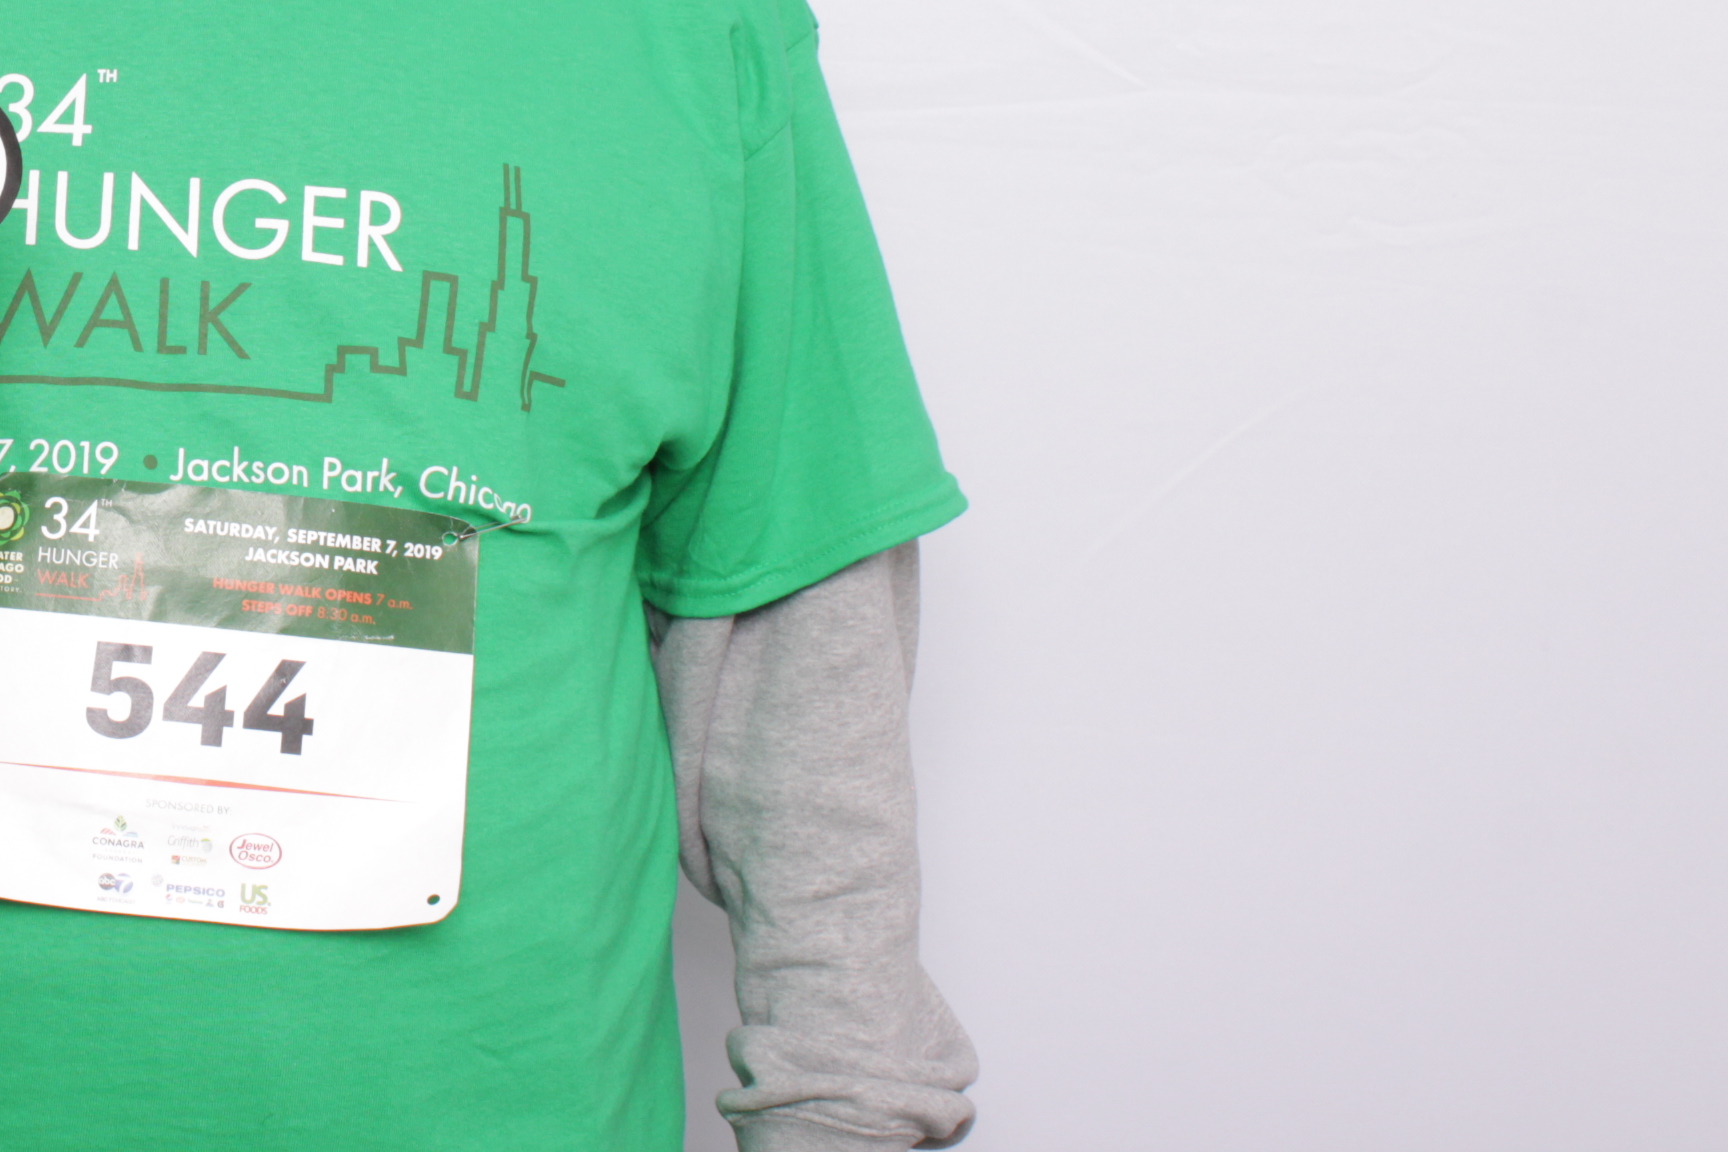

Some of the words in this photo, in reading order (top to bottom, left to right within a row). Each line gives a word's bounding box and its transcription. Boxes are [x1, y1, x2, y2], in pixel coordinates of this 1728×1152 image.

[29, 438, 120, 475] 2019
[169, 446, 309, 487] Jackson
[322, 456, 403, 498] Park,
[184, 518, 280, 543] SATURDAY,
[287, 528, 381, 554] SEPTEMBER
[385, 539, 398, 557] 7,
[403, 542, 443, 561] 2019
[37, 546, 119, 569] HUNGER
[245, 547, 329, 569] JACKSON
[333, 555, 379, 575] PARK
[37, 569, 91, 588] WALK
[213, 577, 274, 594] HUNGER
[278, 583, 322, 599] WALK
[325, 588, 372, 605] OPENS
[375, 593, 385, 605] 7
[387, 598, 413, 609] a.m.
[242, 599, 282, 614] STEPS
[285, 603, 313, 617] OFF
[317, 606, 348, 621] 8:30
[350, 613, 376, 625] a.m.
[84, 640, 315, 756] 544
[145, 798, 214, 814] SPONSORED
[92, 836, 144, 850] CONAGRA
[167, 835, 199, 851] Griffith
[237, 838, 273, 853] Jewel
[92, 853, 143, 864] FOUNDATION
[181, 855, 207, 864] CUSTOM
[166, 884, 225, 898] PEPSICO
[239, 904, 268, 916] FOODS
